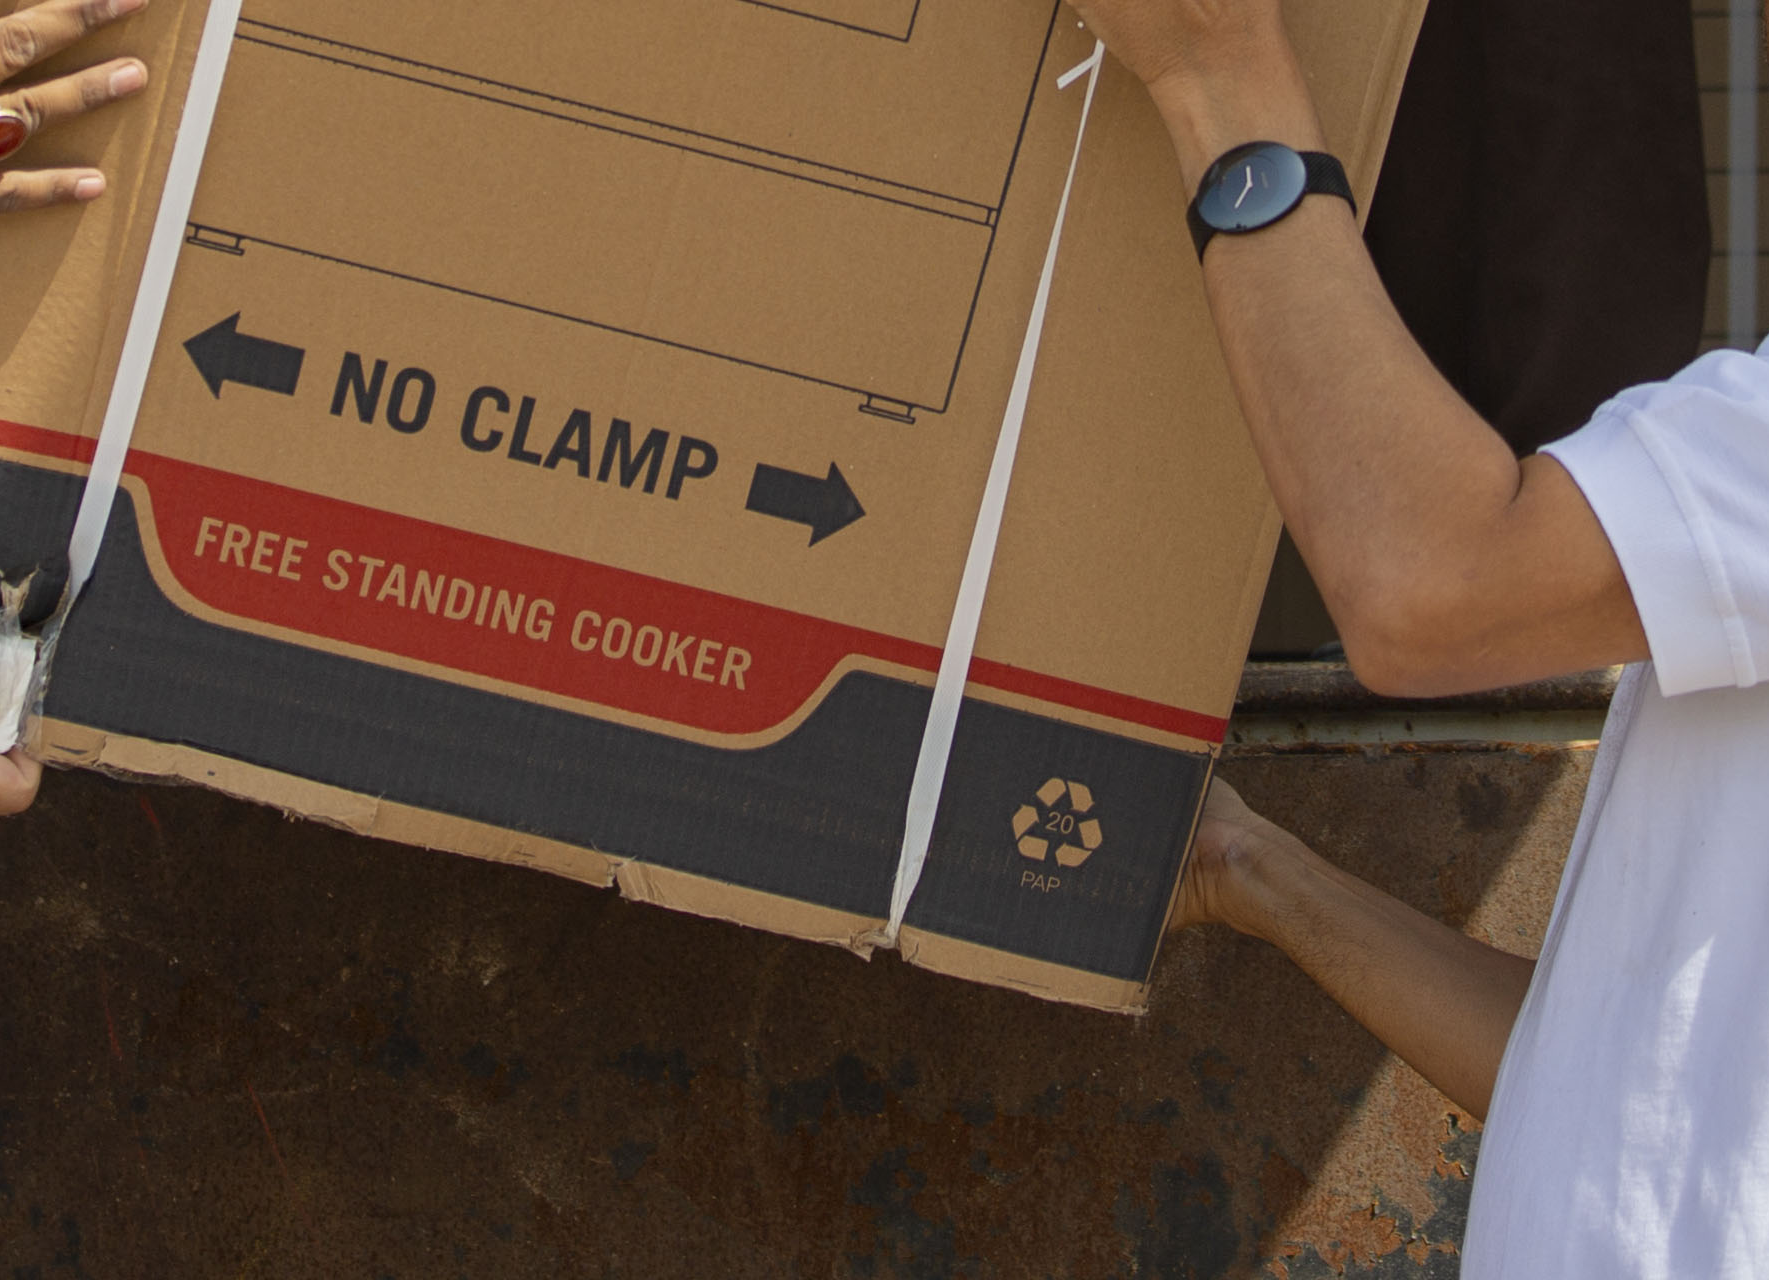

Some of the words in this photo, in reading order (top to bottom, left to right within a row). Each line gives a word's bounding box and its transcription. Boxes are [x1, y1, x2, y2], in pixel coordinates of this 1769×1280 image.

[328, 350, 439, 439] NO
[459, 384, 720, 503] CLAMP
[193, 514, 309, 583] FREE
[320, 547, 555, 643] STANDING
[569, 608, 755, 691] COOKER
[1045, 811, 1075, 835] 20
[1020, 870, 1061, 894] PAP
